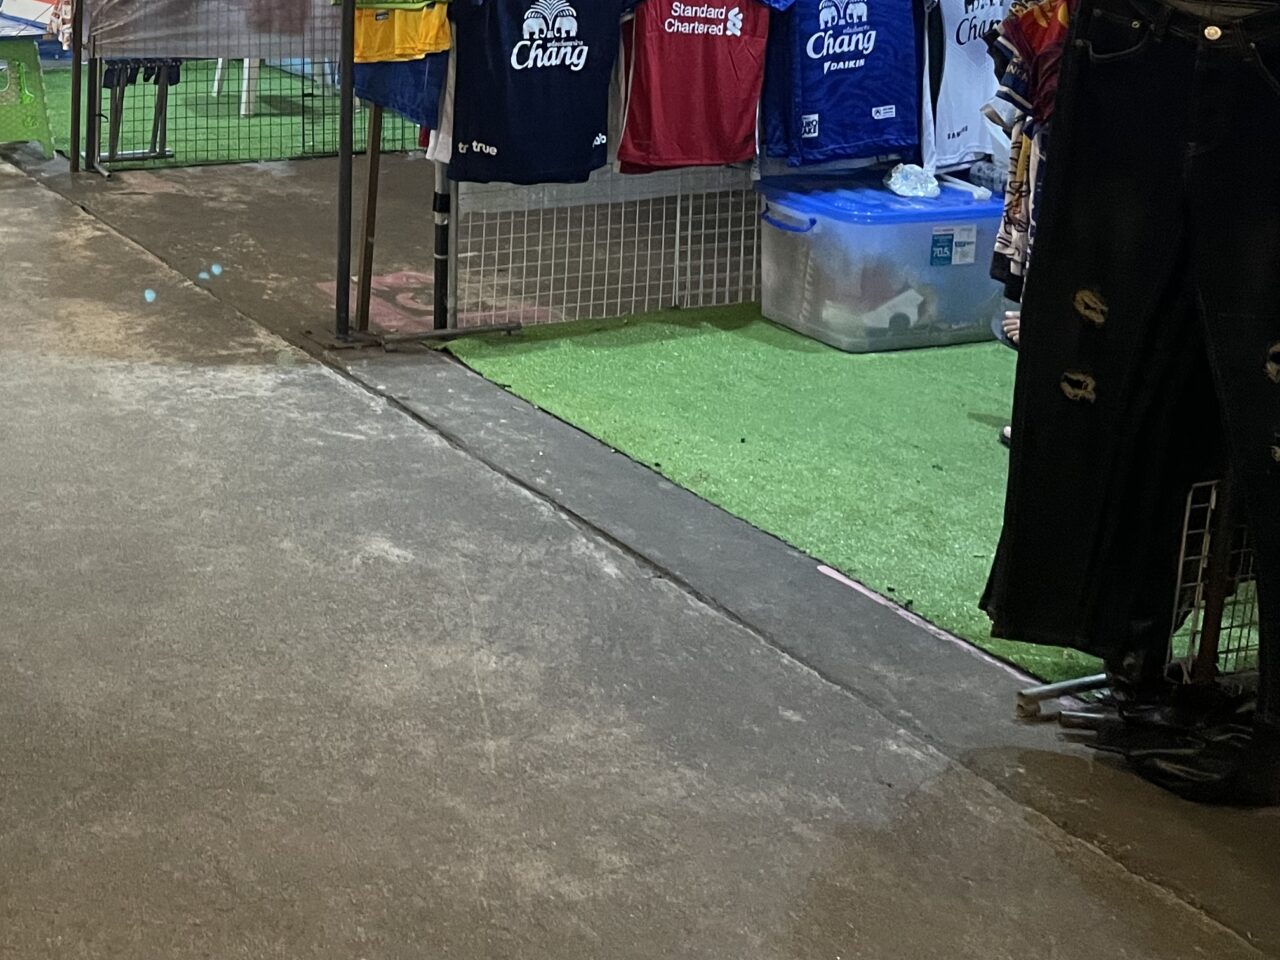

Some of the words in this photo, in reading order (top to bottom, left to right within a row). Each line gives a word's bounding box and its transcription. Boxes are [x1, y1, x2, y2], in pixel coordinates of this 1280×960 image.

[671, 1, 727, 19] Standard
[664, 18, 724, 35] Chartered
[806, 30, 877, 59] Chang
[510, 40, 589, 71] Chang
[830, 58, 865, 71] DAIKIN
[471, 140, 498, 156] true
